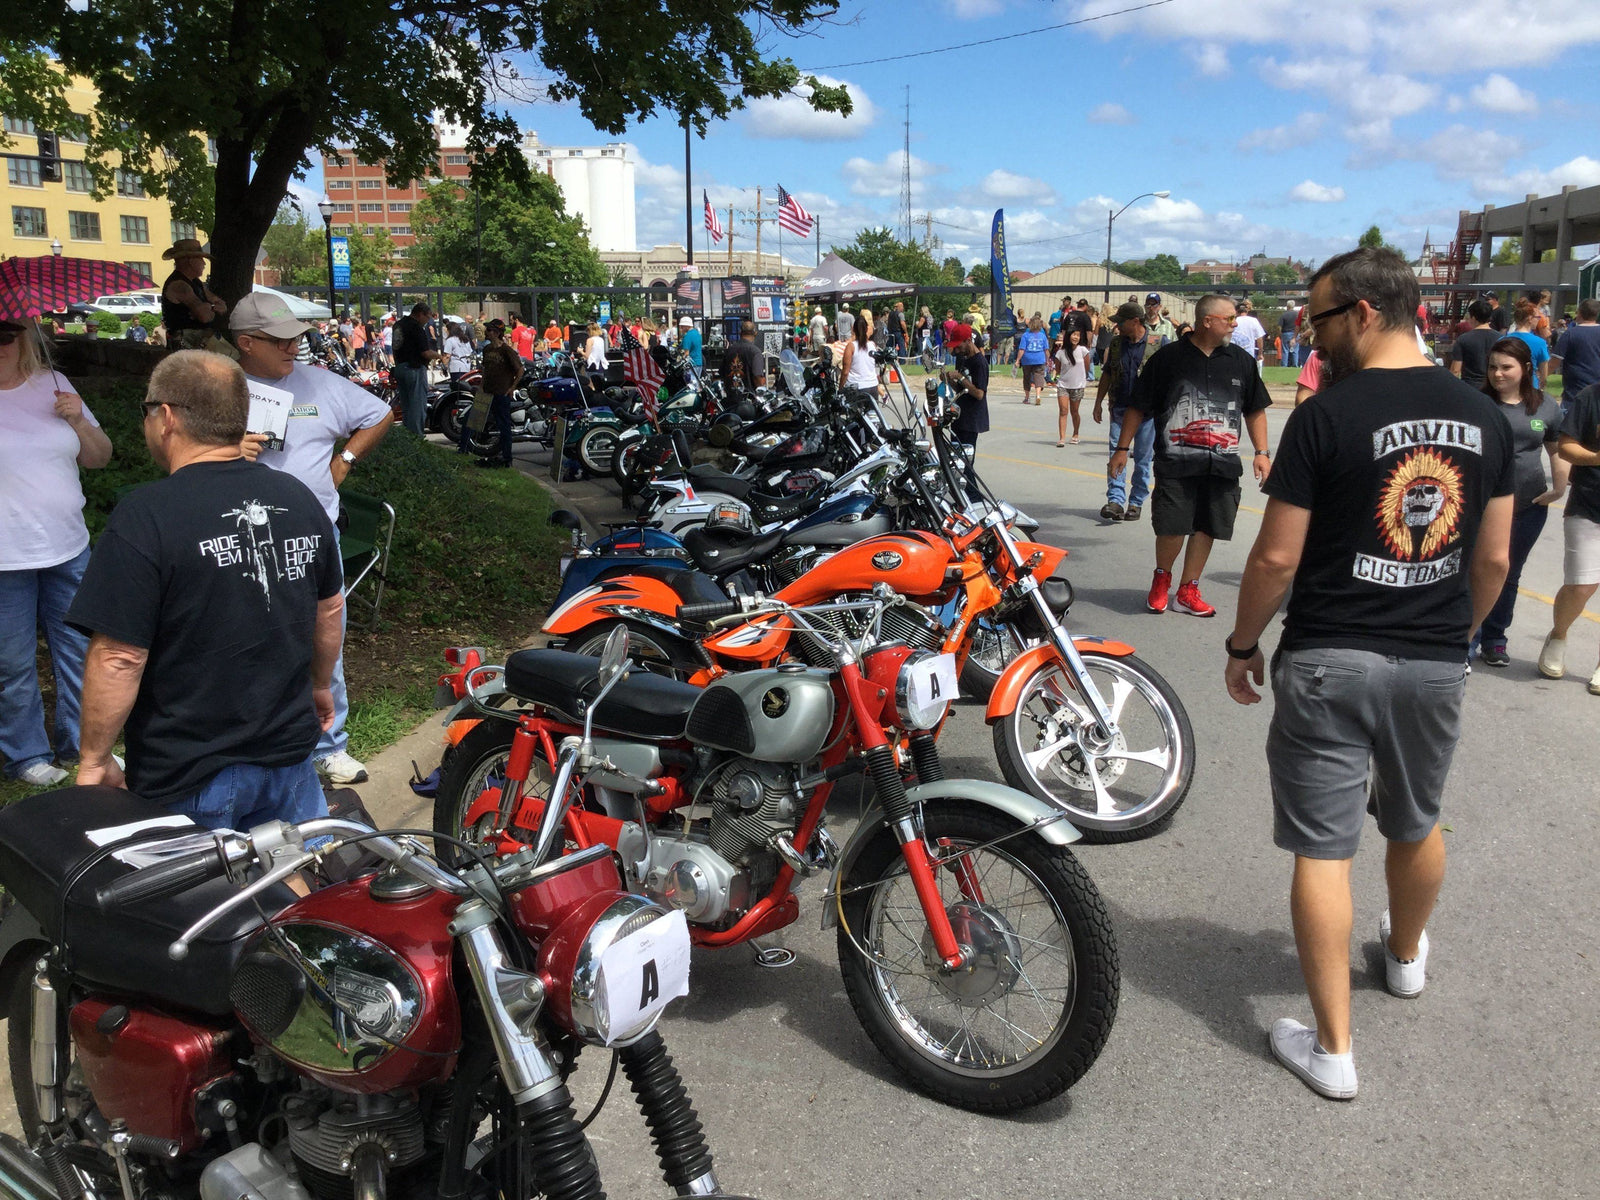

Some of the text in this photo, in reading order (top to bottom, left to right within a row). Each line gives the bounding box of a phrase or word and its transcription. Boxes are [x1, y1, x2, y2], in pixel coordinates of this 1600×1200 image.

[998, 221, 1012, 309] ATTRACTION
[1380, 422, 1477, 454] ANVIL
[199, 534, 241, 556] RIDE
[285, 550, 317, 567] HIDE
[1357, 554, 1460, 585] CUSTOMS
[929, 672, 941, 700] A
[638, 958, 659, 1012] A
